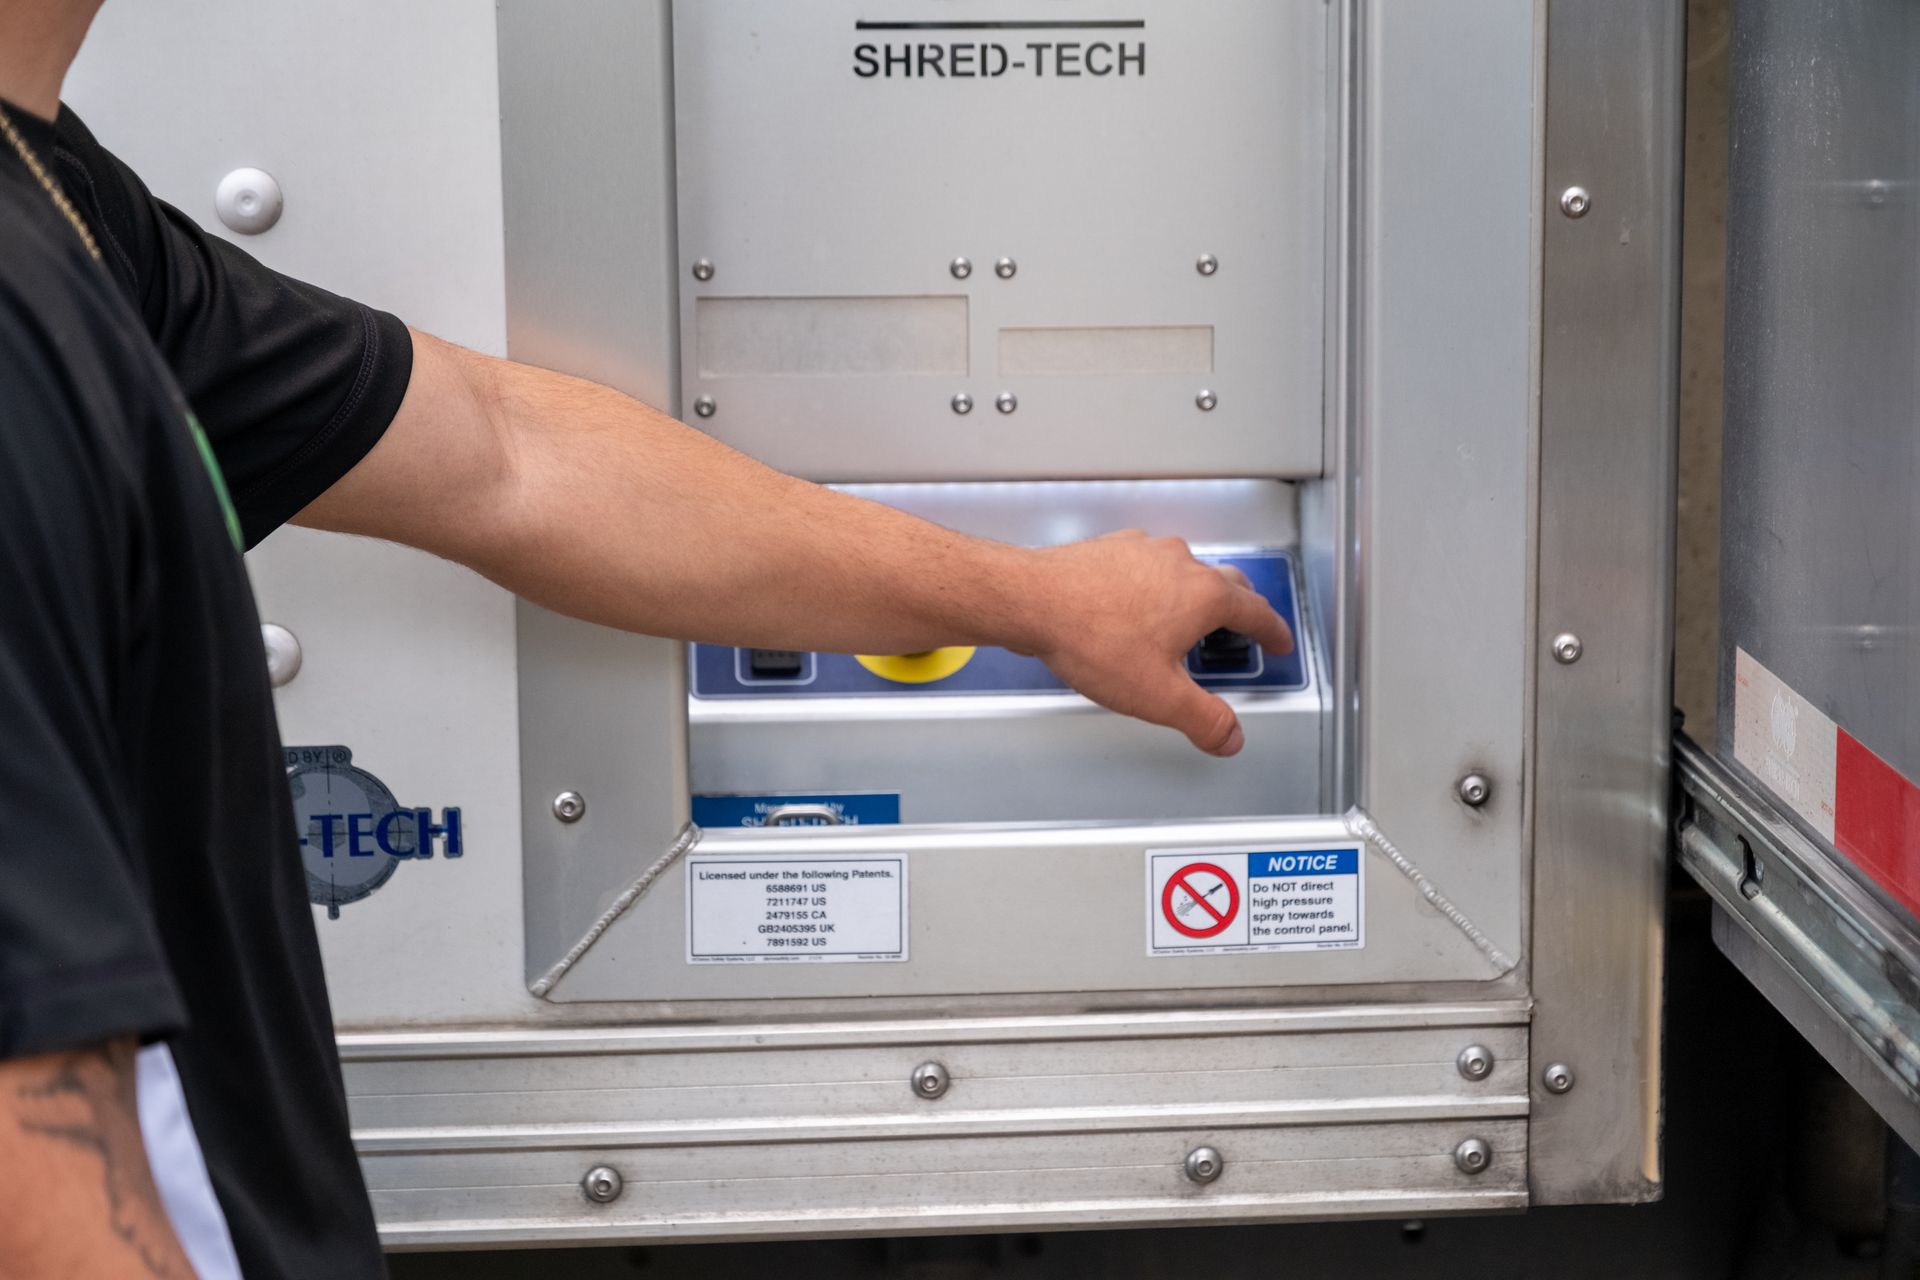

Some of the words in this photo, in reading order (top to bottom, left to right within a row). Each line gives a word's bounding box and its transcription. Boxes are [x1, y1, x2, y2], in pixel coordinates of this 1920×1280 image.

[853, 43, 1146, 77] SHRED-TECH
[303, 751, 321, 763] BY
[299, 810, 459, 858] -TECH
[1268, 855, 1338, 872] NOTICE
[699, 872, 746, 880] Licensed
[782, 871, 799, 879] the
[801, 870, 849, 880] following
[852, 870, 894, 878] Patents.
[766, 885, 808, 893] 6588691
[811, 884, 827, 892] US
[1253, 884, 1269, 893] Do
[1272, 883, 1297, 892] NOT
[1301, 881, 1334, 891] direct
[766, 898, 809, 906] 7211747
[811, 898, 827, 906] US
[1253, 898, 1278, 909] high
[1282, 897, 1333, 908] pressure
[766, 911, 808, 920] 2479155
[811, 911, 827, 919] CA
[1253, 912, 1285, 923] spray
[1289, 910, 1334, 920] towards
[758, 925, 816, 933] GB2405395
[820, 924, 835, 932] UK
[1253, 926, 1271, 936] the
[1274, 924, 1315, 935] control
[1319, 923, 1354, 936] panel.
[767, 938, 809, 946] 7891592
[812, 938, 827, 946] US
